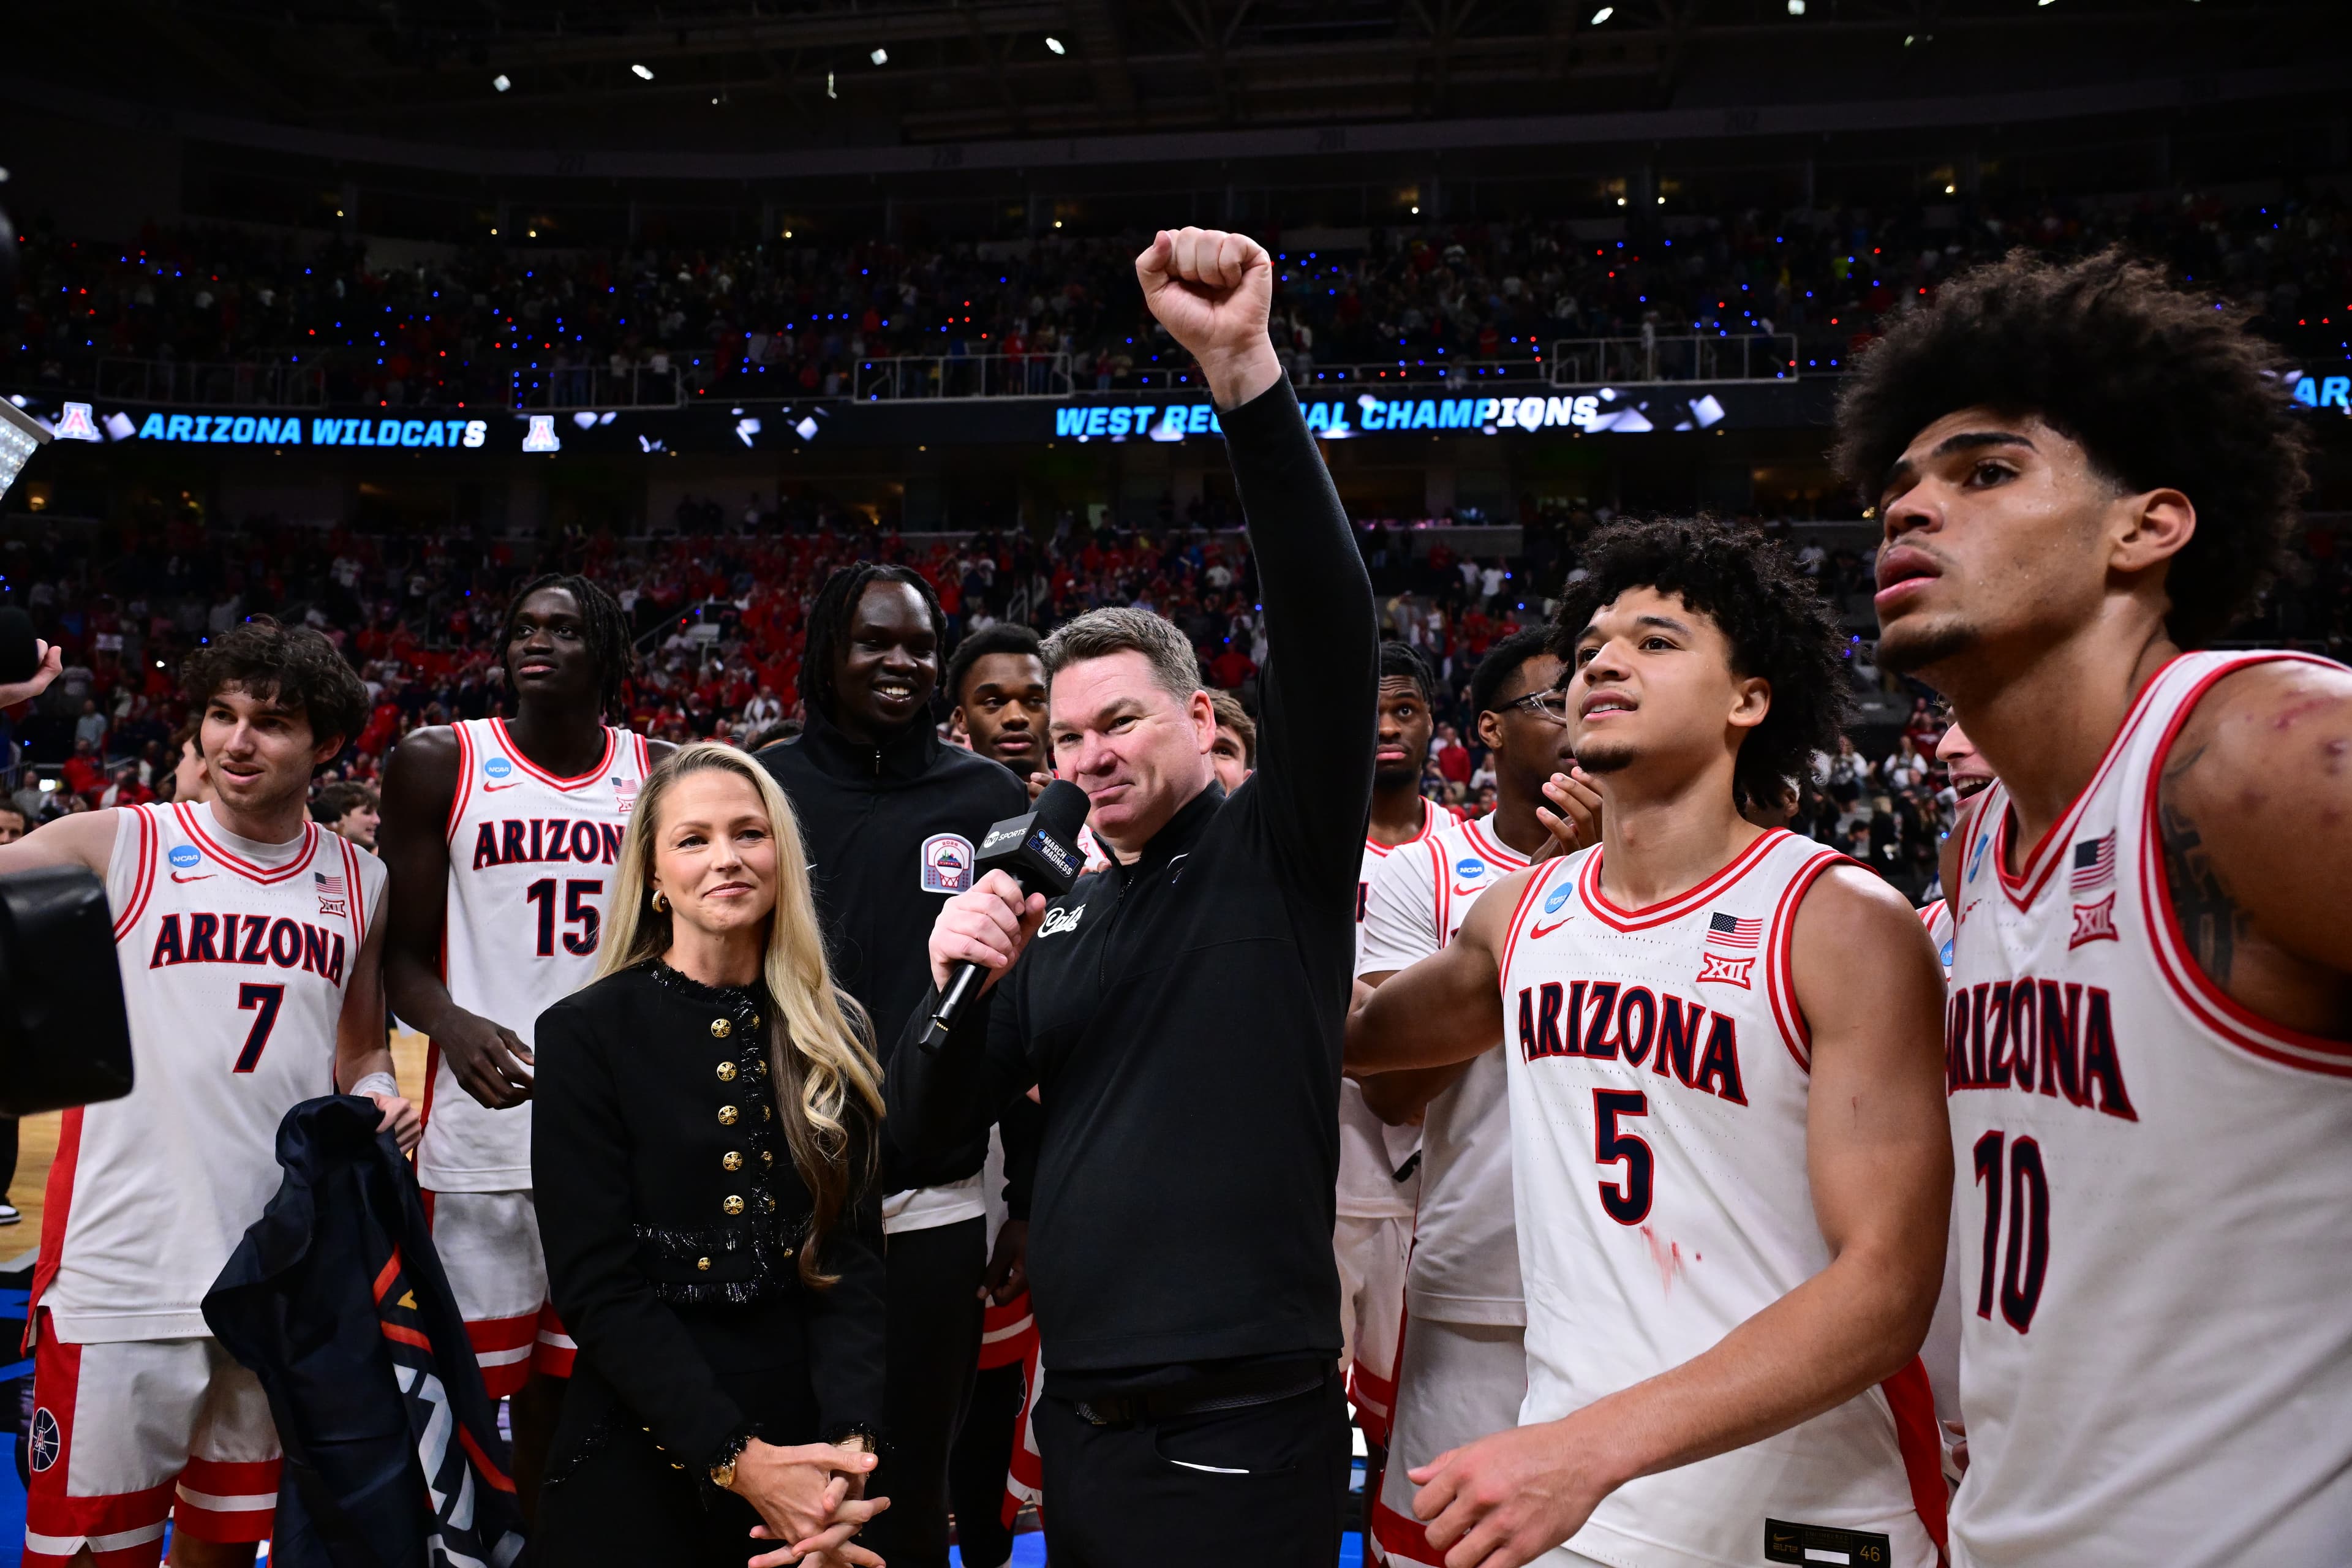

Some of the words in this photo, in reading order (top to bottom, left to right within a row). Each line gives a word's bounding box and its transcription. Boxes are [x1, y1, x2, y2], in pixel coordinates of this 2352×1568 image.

[139, 412, 302, 445] ARIZONA
[312, 417, 488, 448] WILDCATS
[1055, 405, 1156, 437] WEST
[1161, 401, 1351, 435] REAL
[1362, 395, 1599, 431] CHAMPIONS
[473, 819, 625, 870] ARIZON
[998, 828, 1027, 841] SPORTS
[1043, 835, 1068, 859] MARCH
[173, 854, 199, 863] NCAA
[1042, 846, 1074, 876] MADNESS
[527, 878, 603, 957] 15
[1037, 903, 1086, 938] Cats
[2070, 892, 2118, 949] XII
[149, 912, 345, 988] ARIZONA
[1697, 953, 1754, 988] XII
[233, 982, 285, 1073] 7
[1518, 981, 1749, 1107] ARIZONA
[1593, 1088, 1654, 1226] 5
[1973, 1129, 2049, 1335] 10
[1858, 1545, 1881, 1562] 46
